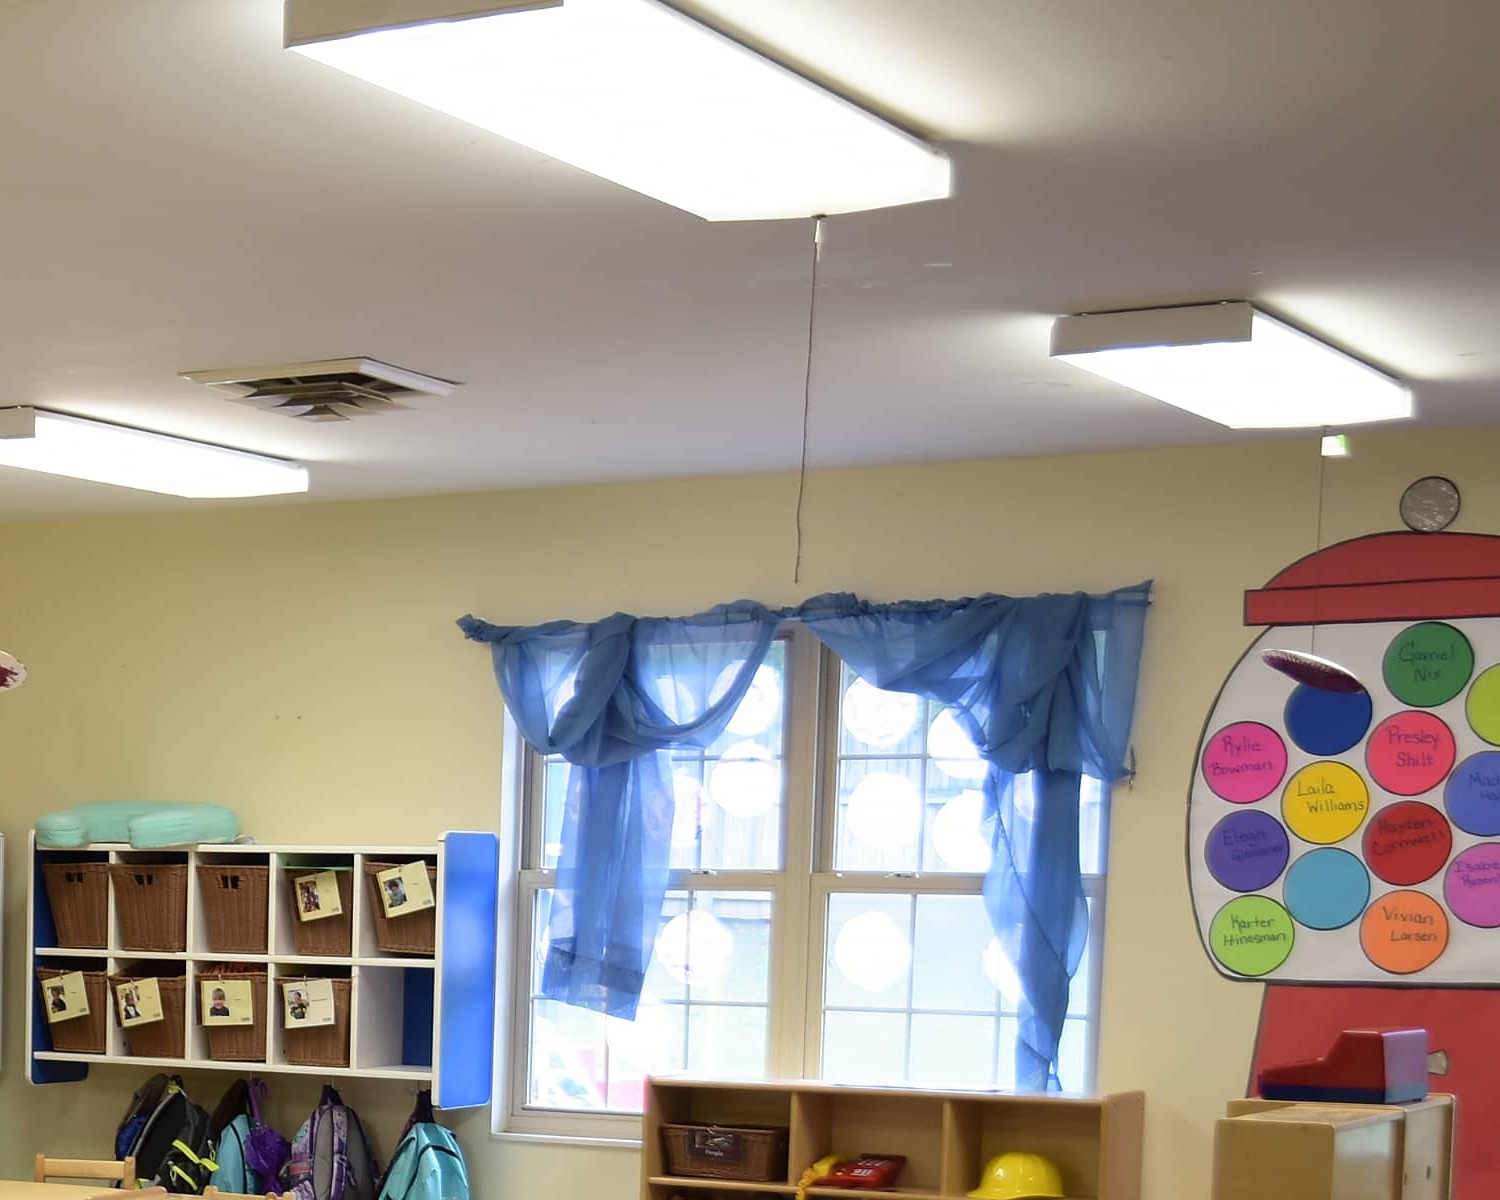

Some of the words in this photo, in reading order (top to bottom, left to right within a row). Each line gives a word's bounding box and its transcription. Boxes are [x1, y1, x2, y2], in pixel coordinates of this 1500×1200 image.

[1386, 725, 1439, 750] Presley
[1209, 762, 1274, 776] Bowman
[1297, 776, 1336, 797] Laila
[1306, 799, 1365, 814] Williams
[1382, 906, 1434, 925] Vivian
[1390, 929, 1437, 942] Larsen
